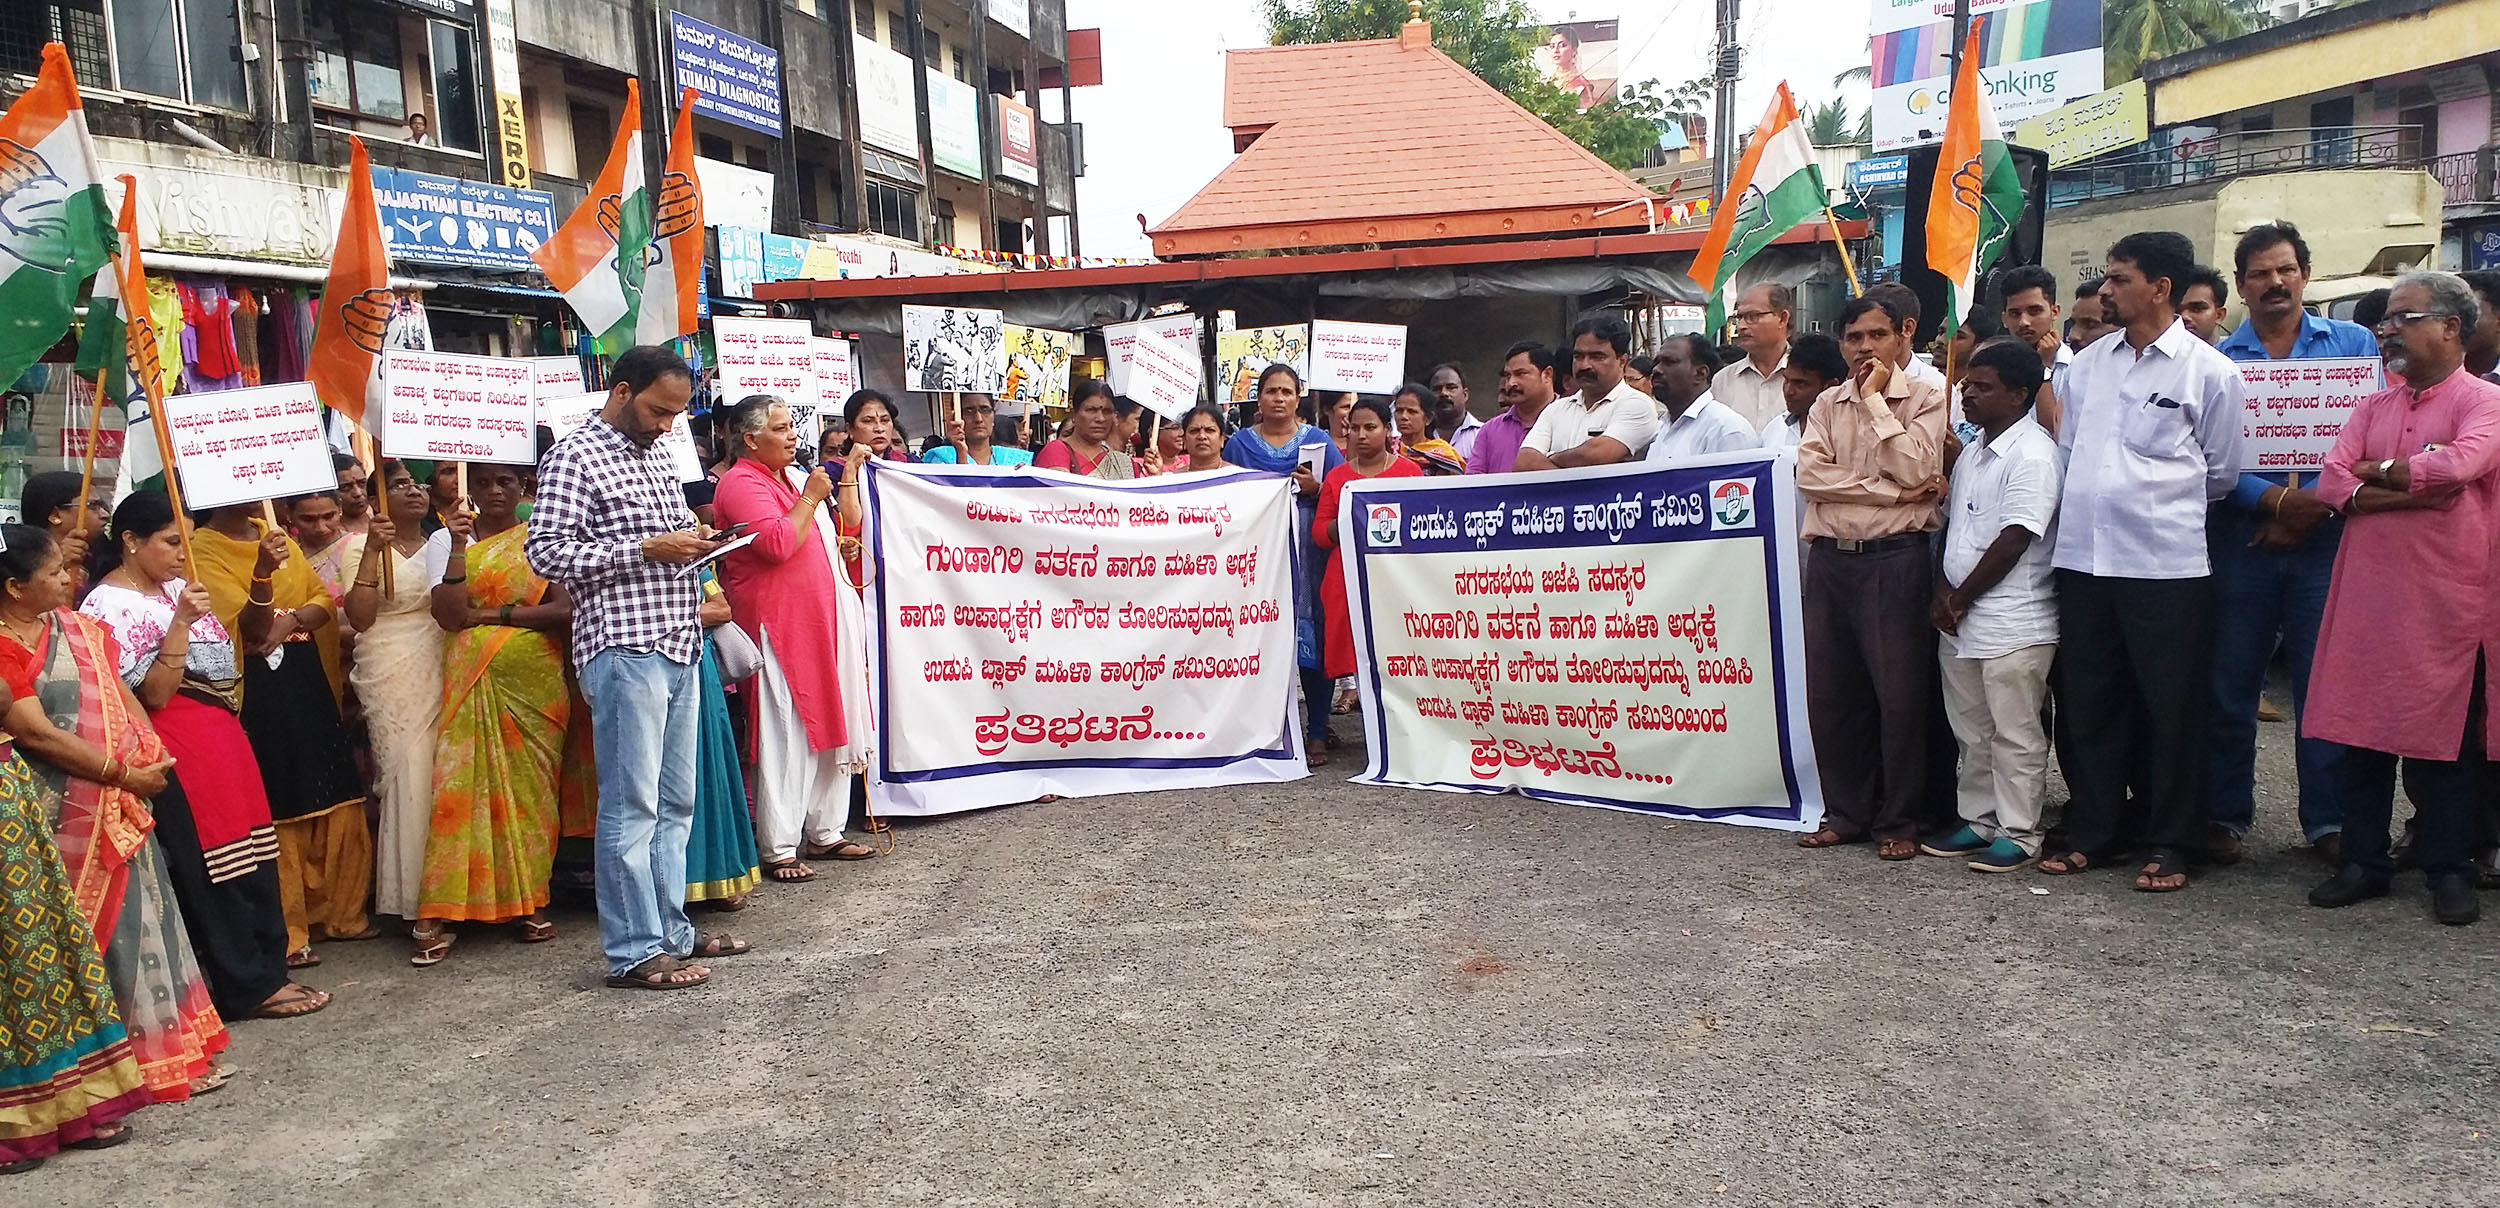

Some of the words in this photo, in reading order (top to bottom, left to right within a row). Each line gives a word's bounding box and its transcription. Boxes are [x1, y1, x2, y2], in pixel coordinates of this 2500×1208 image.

[1933, 2, 1955, 15] Udu
[678, 67, 717, 95] KUMAR
[719, 80, 780, 115] DIAGNOSTICS
[1876, 139, 1894, 147] Udupi
[2072, 120, 2136, 158] MAHAL
[1860, 171, 1896, 184] ASHIRVAD
[374, 188, 458, 215] RAJASTHAN
[460, 200, 523, 224] ELECTRIC
[524, 209, 545, 227] CO.
[2483, 232, 2500, 251] Lib
[2078, 265, 2109, 281] SHAS
[724, 333, 757, 349] ಅಭಿವೃದ್ಧಿ
[762, 335, 806, 344] ಉಡುಪಿಯ
[390, 357, 430, 374] ನಗರಸಭೆಯ
[434, 362, 462, 380] ಅಧ್ಯಕ್ಷರು
[465, 364, 482, 381] ಮತ್ತು
[723, 354, 755, 365] ಸಹಿಸದ
[760, 354, 783, 365] ಬಿಜೆಪಿ
[789, 356, 812, 371] ಪಕ್ಷಕ್ಕೆ
[740, 376, 768, 392] ಧಿಕ್ಕಾರ
[774, 376, 801, 392] ಧಿಕ್ಕಾರ
[2269, 367, 2298, 388] ಅಧ್ಯಕ್ಷರು
[2303, 367, 2321, 385] ಮತ್ತು
[393, 385, 427, 406] ಅವಾಚ್ಯ
[487, 391, 527, 406] ನಿಂದಿಸಿದ
[173, 414, 213, 434] ಅಭಿವೃದ್ಧಿಯ
[254, 406, 281, 418] ಮಹಿಳಾ
[285, 399, 315, 415] ವಿರೋಧಿ
[392, 409, 418, 424] ಬಿಜೆಪಿ
[424, 414, 472, 430] ನಗರಸಭಾ
[477, 417, 528, 438] ಸದಸ್ಯರನ್ನು
[2256, 422, 2307, 439] ನಗರಸಭಾ
[182, 442, 202, 457] ಬಿಜೆಪಿ
[206, 438, 226, 458] ಪಕ್ಷದ
[230, 434, 267, 450] ನಗರಸಭಾ
[271, 427, 320, 450] ಸದಸ್ಯರುಗಳಿಗೆ
[427, 439, 493, 456] ವಜಾಗೊಳಿಸಿ
[232, 463, 256, 484] ಧಿಕ್ಕಾರ
[260, 459, 284, 480] ಧಿಕ್ಕಾರ
[966, 503, 1022, 523] ಉಡುಪಿ
[1029, 502, 1119, 528] ನಗರಸಭೆಯ
[1129, 506, 1169, 527] ಬಿಜೆಪಿ
[1178, 505, 1231, 537] ಸದಸ್ಯರ
[1410, 504, 1458, 541] ಉಡುಪಿ
[1464, 503, 1505, 549] ಬ್ಲಾಕ್
[1512, 501, 1564, 536] ಮಹಿಳಾ
[1573, 489, 1642, 545] ಕಾಂಗ್ರೆಸ್
[1653, 493, 1704, 529] ಸಮಿತಿ
[926, 540, 1023, 573] ಗುಂಡಾಗಿರಿ
[1034, 544, 1099, 577] ವರ್ತನೆ
[1107, 553, 1156, 577] ಹಾಗೂ
[1164, 553, 1217, 576] ಮಹಿಳಾ
[1226, 546, 1257, 587] ಅಧ್ಯಕ್ಷೆ
[1455, 564, 1533, 598] ನಗರಸಭೆಯ
[1542, 562, 1579, 592] ಬಿಜೆಪಿ
[1588, 563, 1645, 606] ಸದಸ್ಯರ
[900, 603, 945, 628] ಹಾಗೂ
[954, 600, 1042, 643] ಉಪಾಧ್ಯಕ್ಷೆಗೆ
[1051, 599, 1110, 629] ಅಗೌರವ
[1119, 602, 1234, 638] ತೋರಿಸುವುದನ್ನು
[1240, 600, 1279, 625] ಖಂಡಿಸಿ
[1404, 610, 1479, 638] ಗುಂಡಾಗಿರಿ
[1486, 603, 1541, 639] ವರ್ತನೆ
[1549, 613, 1596, 639] ಹಾಗೂ
[1605, 612, 1658, 638] ಮಹಿಳಾ
[1668, 605, 1717, 653] ಅಧ್ಯಕ್ಷೆ
[924, 657, 973, 682] ಉಡುಪಿ
[981, 656, 1027, 688] ಬ್ಲಾಕ್
[1035, 657, 1091, 683] ಮಹಿಳಾ
[1101, 654, 1166, 691] ಕಾಂಗ್ರೆಸ್
[1173, 652, 1260, 680] ಸಮಿತಿಯಿಂದ
[1387, 654, 1428, 676] ಹಾಗೂ
[1432, 652, 1499, 694] ಉಪಾಧ್ಯಕ್ಷೆಗೆ
[1508, 651, 1558, 682] ಅಗೌರವ
[1566, 653, 1690, 696] ತೋರಿಸುವುದನ್ನು
[1698, 657, 1752, 684] ಖಂಡಿಸಿ
[1417, 697, 1456, 718] ಉಡುಪಿ
[1461, 696, 1494, 726] ಬ್ಲಾಕ್
[1501, 702, 1548, 726] ಮಹಿಳಾ
[1556, 699, 1617, 739] ಕಾಂಗ್ರೆಸ್
[1627, 704, 1727, 732] ಸಮಿತಿಯಿಂದ
